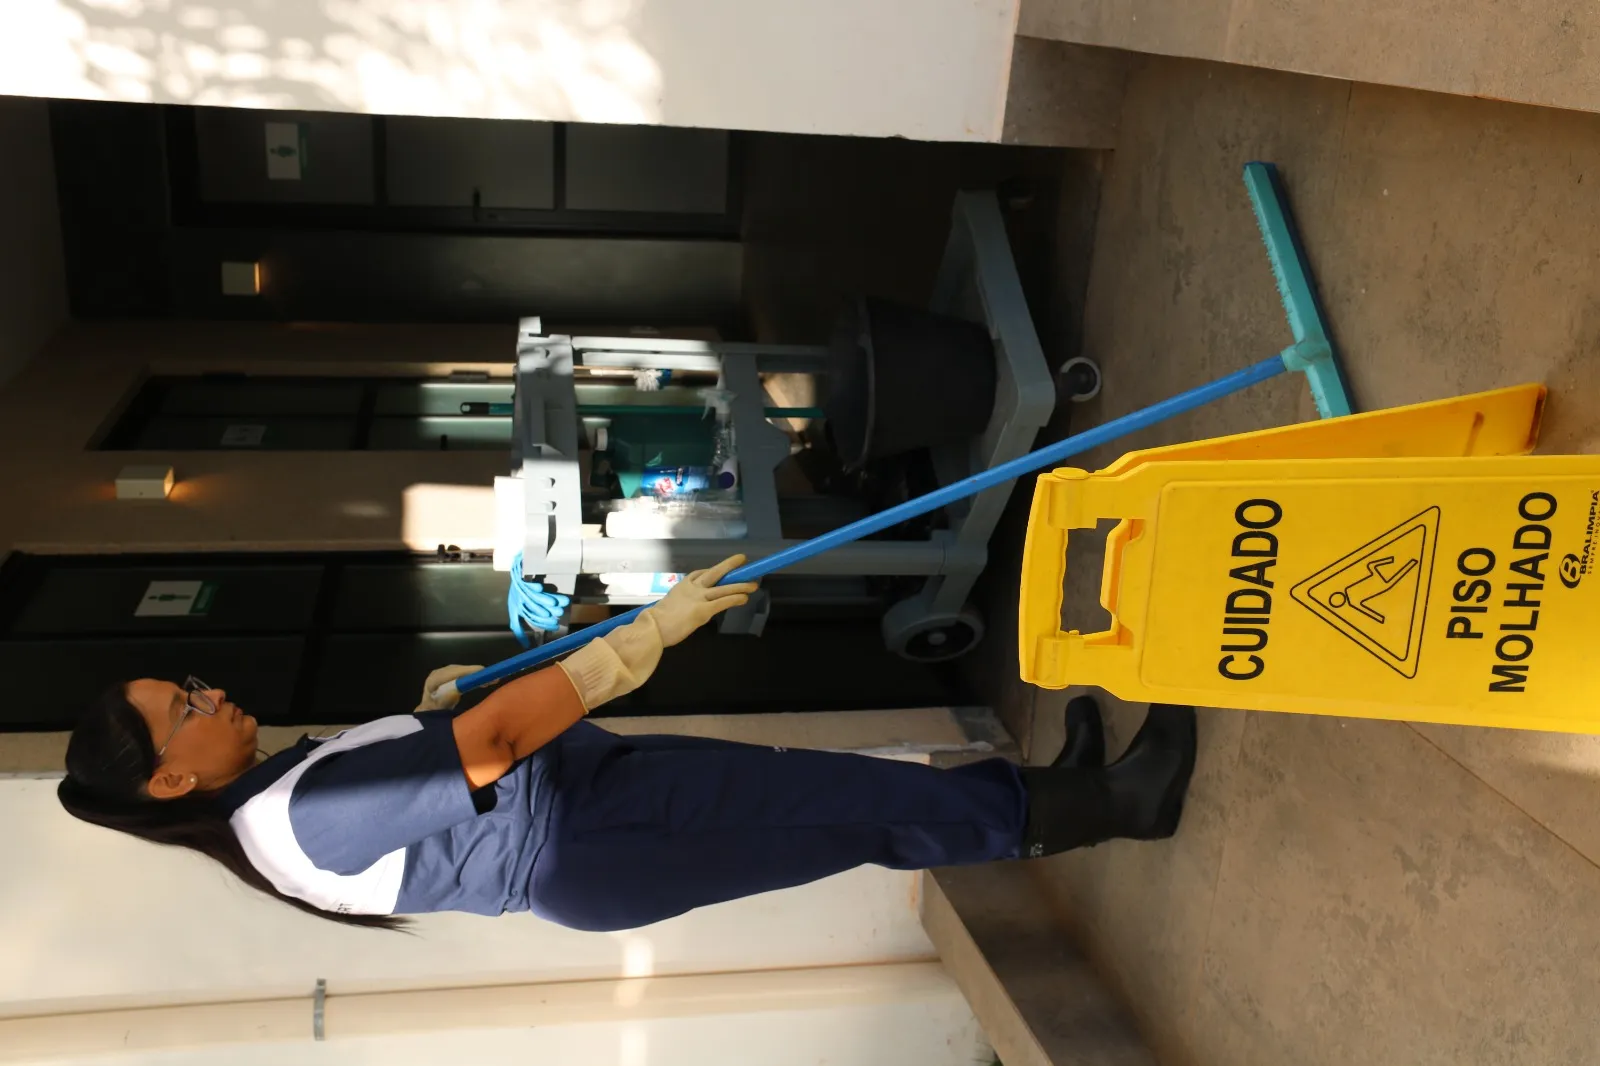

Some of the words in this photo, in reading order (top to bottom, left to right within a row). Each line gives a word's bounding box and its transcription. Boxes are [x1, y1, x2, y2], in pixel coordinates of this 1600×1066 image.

[1217, 498, 1283, 681] CUIDADO
[1445, 547, 1496, 639] PISO
[1488, 491, 1558, 693] MOLHADO
[1579, 490, 1600, 575] BRALIMPIA
